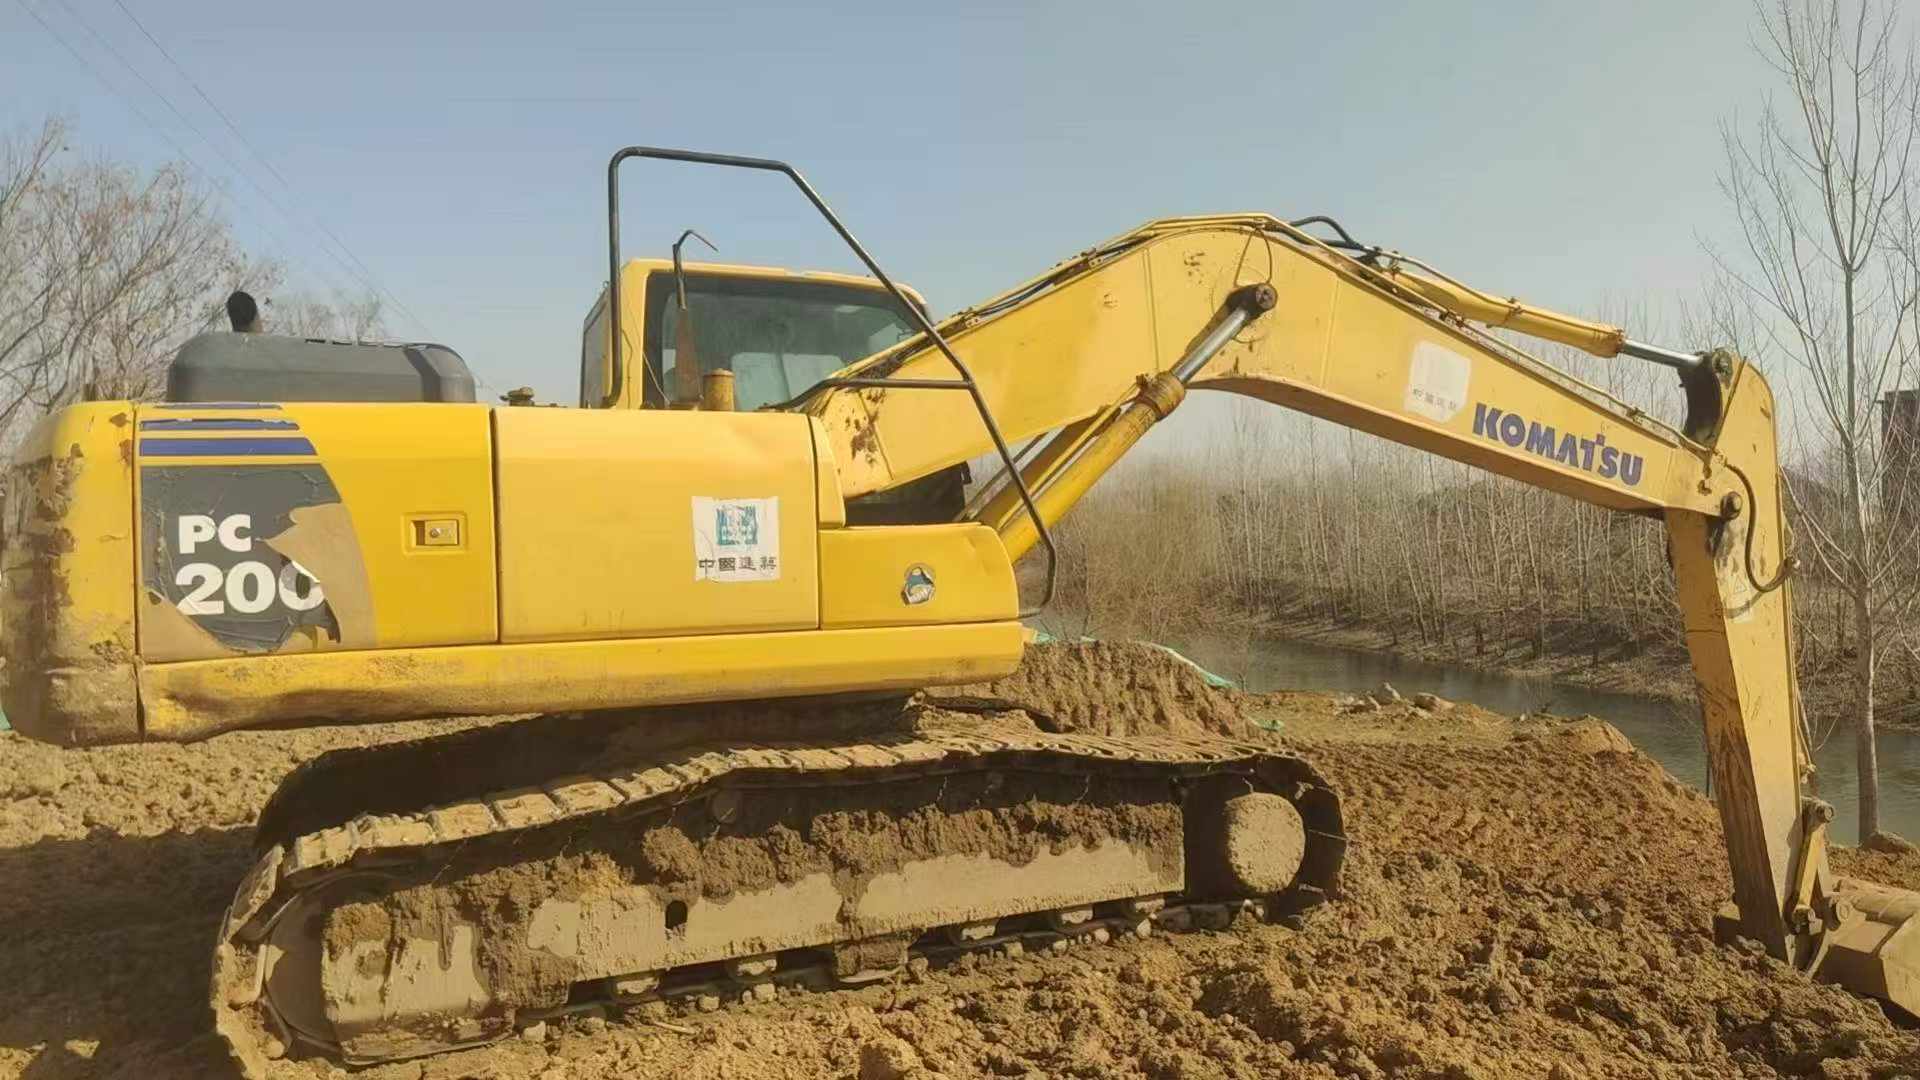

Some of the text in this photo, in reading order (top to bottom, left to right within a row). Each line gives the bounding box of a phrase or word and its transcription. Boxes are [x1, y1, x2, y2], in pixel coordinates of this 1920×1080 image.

[1473, 403, 1643, 486] KOMATSU
[178, 514, 251, 554] PC
[175, 561, 326, 615] 200
